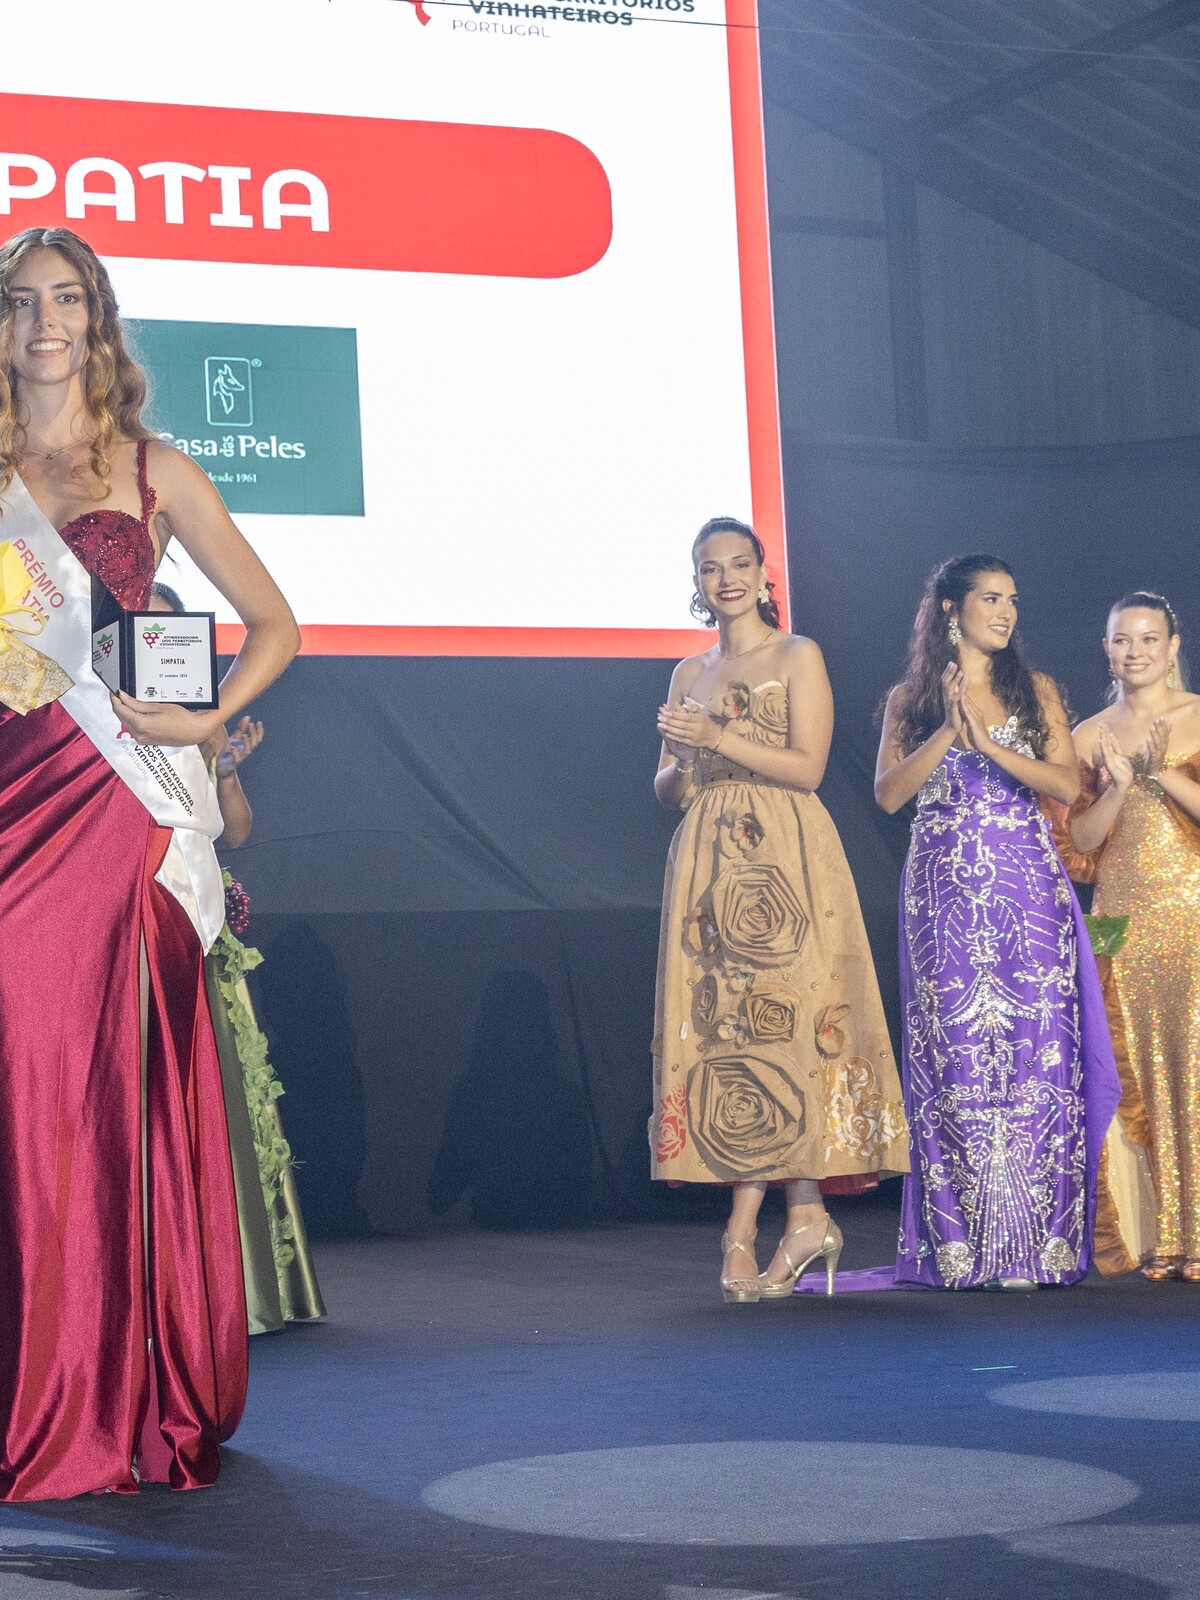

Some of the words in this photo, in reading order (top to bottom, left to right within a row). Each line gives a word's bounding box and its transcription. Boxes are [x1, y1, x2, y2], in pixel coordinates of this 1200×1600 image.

[469, 0, 633, 26] VINHATEIROS
[452, 19, 551, 38] PORTUGAL
[158, 432, 218, 457] asa
[237, 434, 307, 459] Peles
[236, 473, 257, 483] 1961
[13, 538, 65, 609] PRÉMIO
[122, 744, 148, 777] PORTUGAL
[143, 744, 159, 763] DOS
[133, 744, 175, 800] VINHATEIROS
[152, 744, 195, 807] EMBAIXADORA
